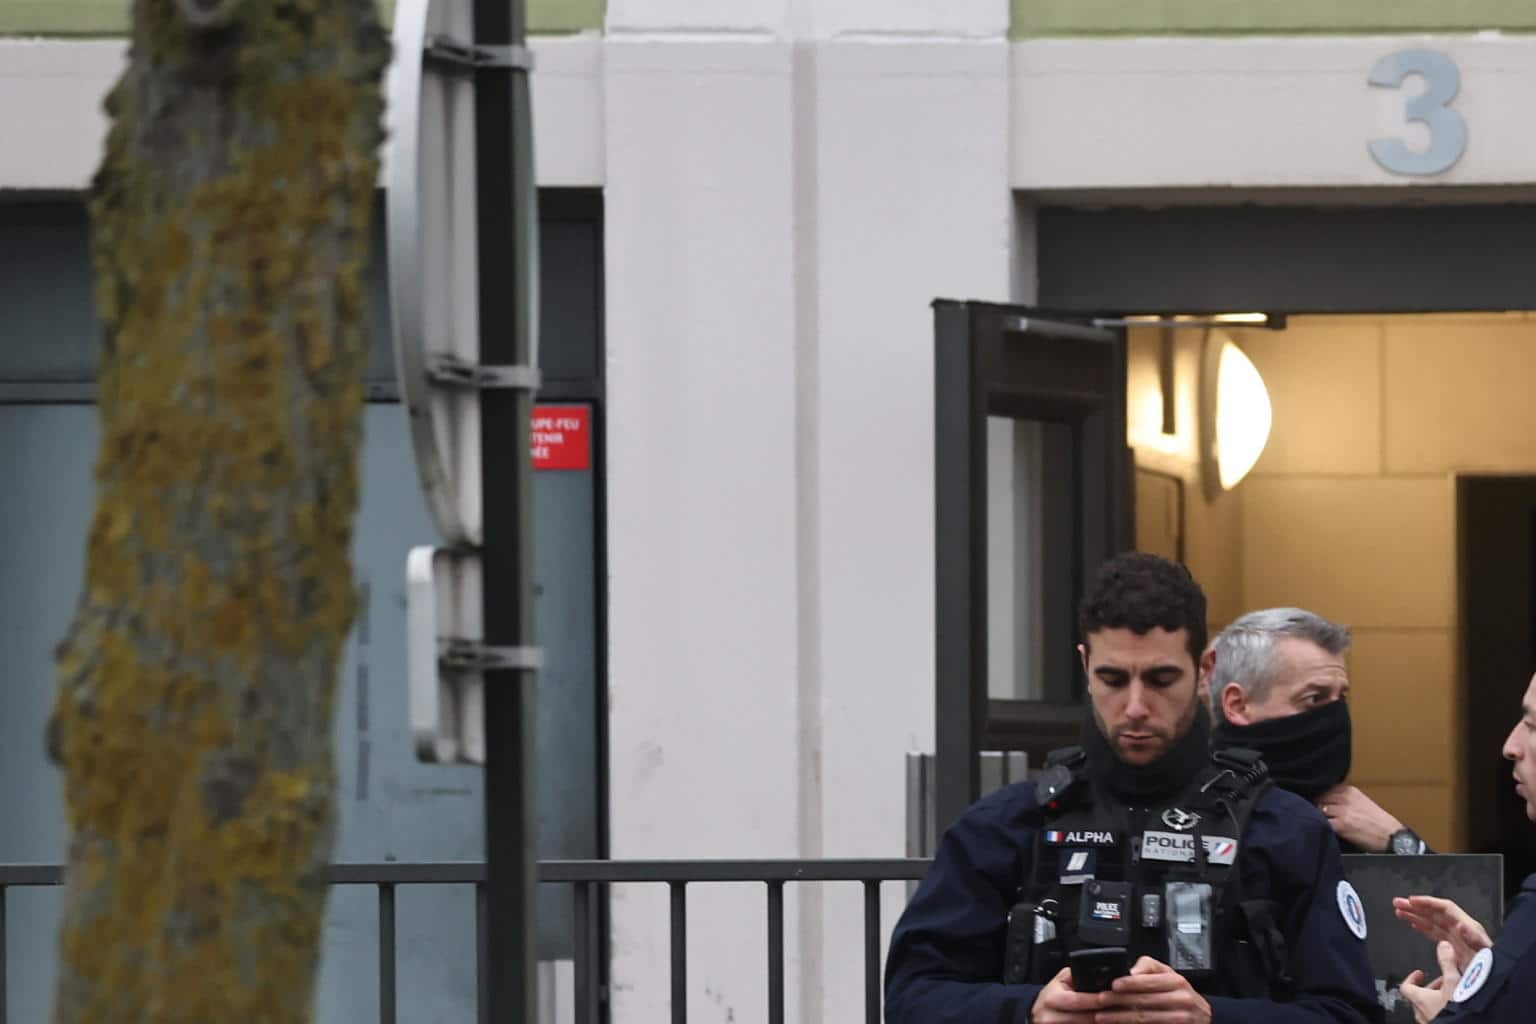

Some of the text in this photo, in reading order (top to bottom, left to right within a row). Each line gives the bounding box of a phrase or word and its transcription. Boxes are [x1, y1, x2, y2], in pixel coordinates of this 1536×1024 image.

[1367, 49, 1469, 177] 3
[1065, 832, 1114, 843] ALPHA
[1147, 836, 1209, 850] POLICE
[1145, 848, 1195, 857] NATIONA
